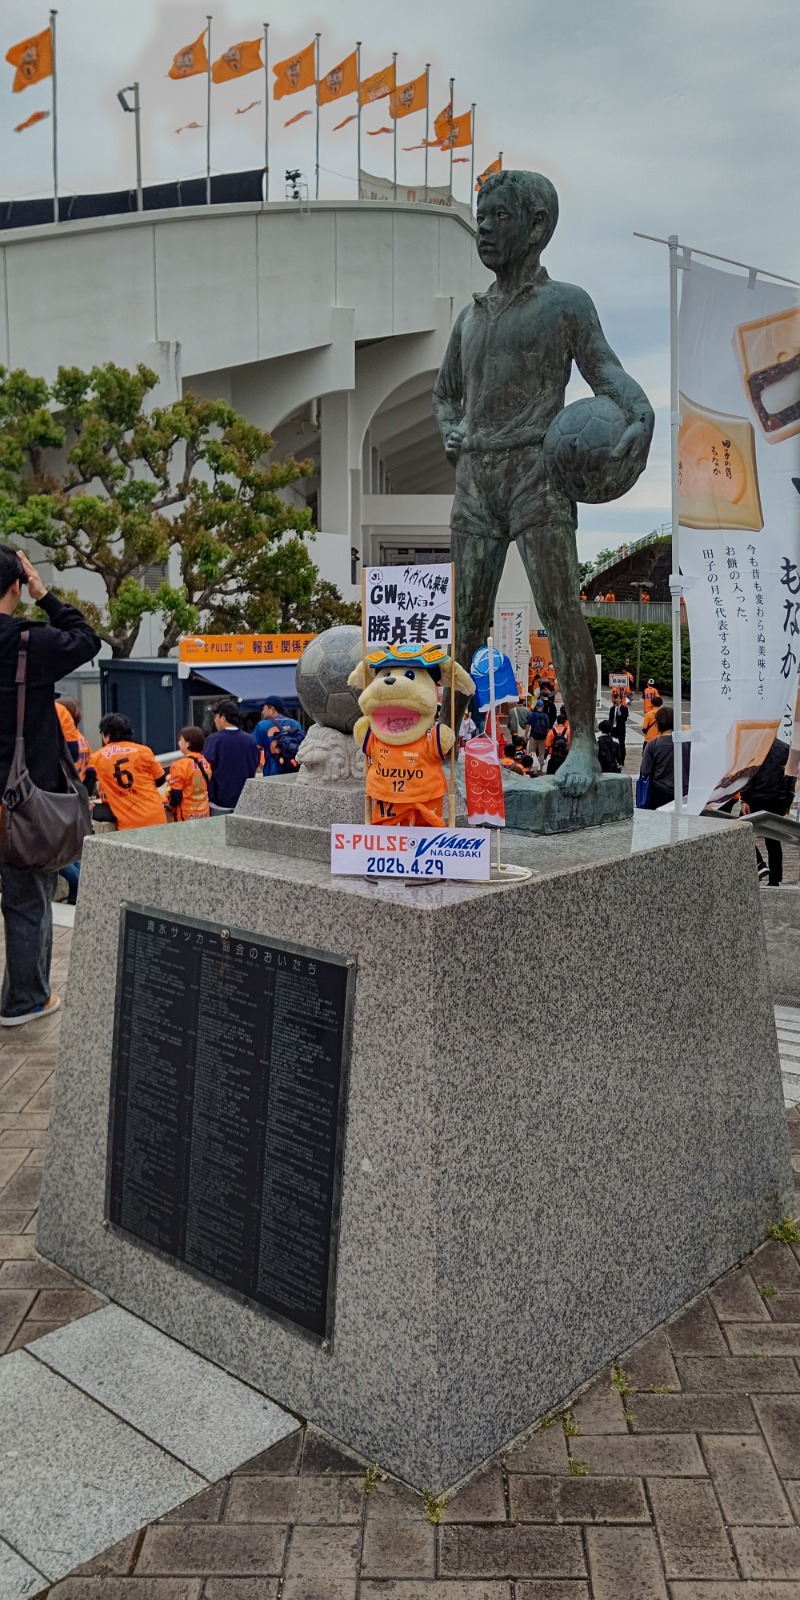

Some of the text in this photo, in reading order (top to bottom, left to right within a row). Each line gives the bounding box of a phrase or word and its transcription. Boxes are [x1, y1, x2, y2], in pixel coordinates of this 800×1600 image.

[711, 446, 721, 476] もなか
[722, 440, 732, 479] 田子の月
[368, 612, 451, 645] 勝点集合
[703, 549, 731, 700] 田子の月を代表するもなか。
[204, 643, 233, 653] S-PULSE
[113, 757, 134, 789] 6
[376, 763, 423, 780] Suzuyo
[392, 781, 405, 792] 12
[377, 800, 397, 817] 12
[335, 834, 408, 851] S-PULSE
[415, 832, 486, 858] V-VAREN
[430, 849, 481, 858] NAGASAKI
[367, 857, 444, 875] 2026.4.29
